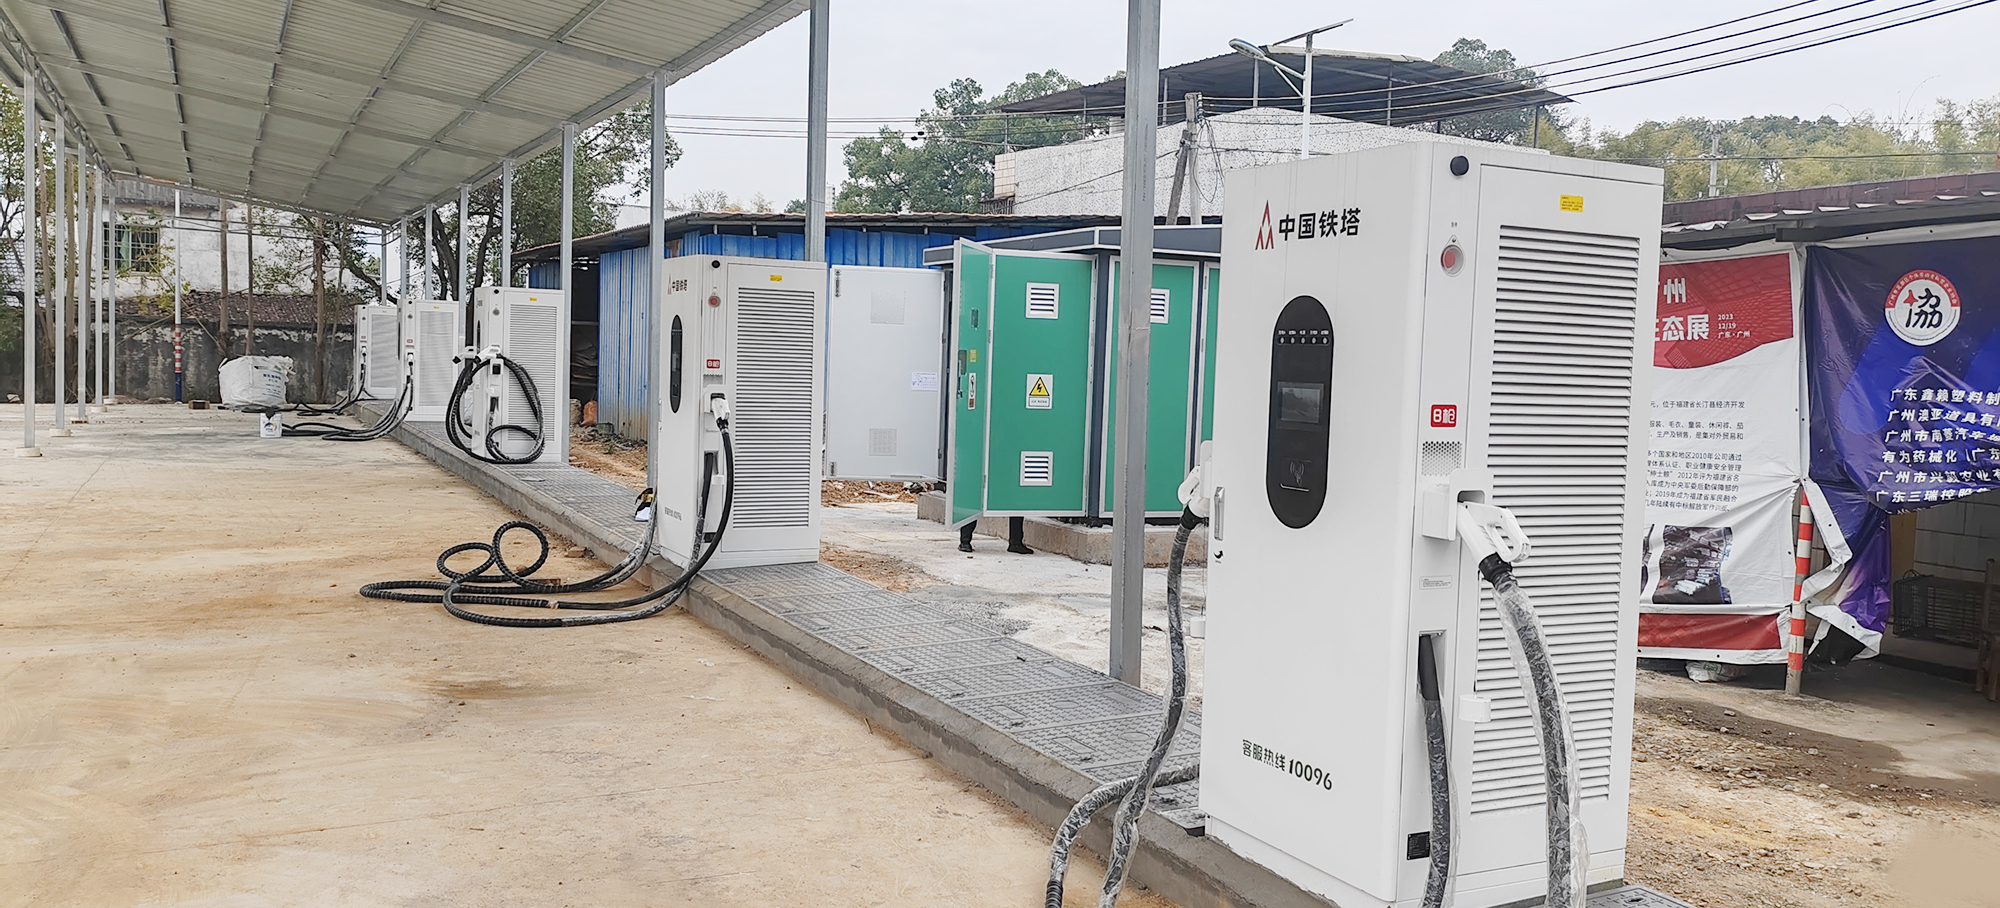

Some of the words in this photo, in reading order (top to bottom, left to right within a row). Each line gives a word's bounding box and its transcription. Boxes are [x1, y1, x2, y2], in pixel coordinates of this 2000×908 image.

[1279, 207, 1361, 241] 中国铁塔
[1658, 277, 1687, 304] 州
[1887, 408, 2000, 428] 广州澳亚道具有
[1648, 431, 1744, 440] 、生产及销售，是集对外贸易和
[1876, 488, 1991, 503] 广东三瑞控股
[1242, 739, 1286, 772] 客服热线
[1288, 758, 1333, 791] 10096
